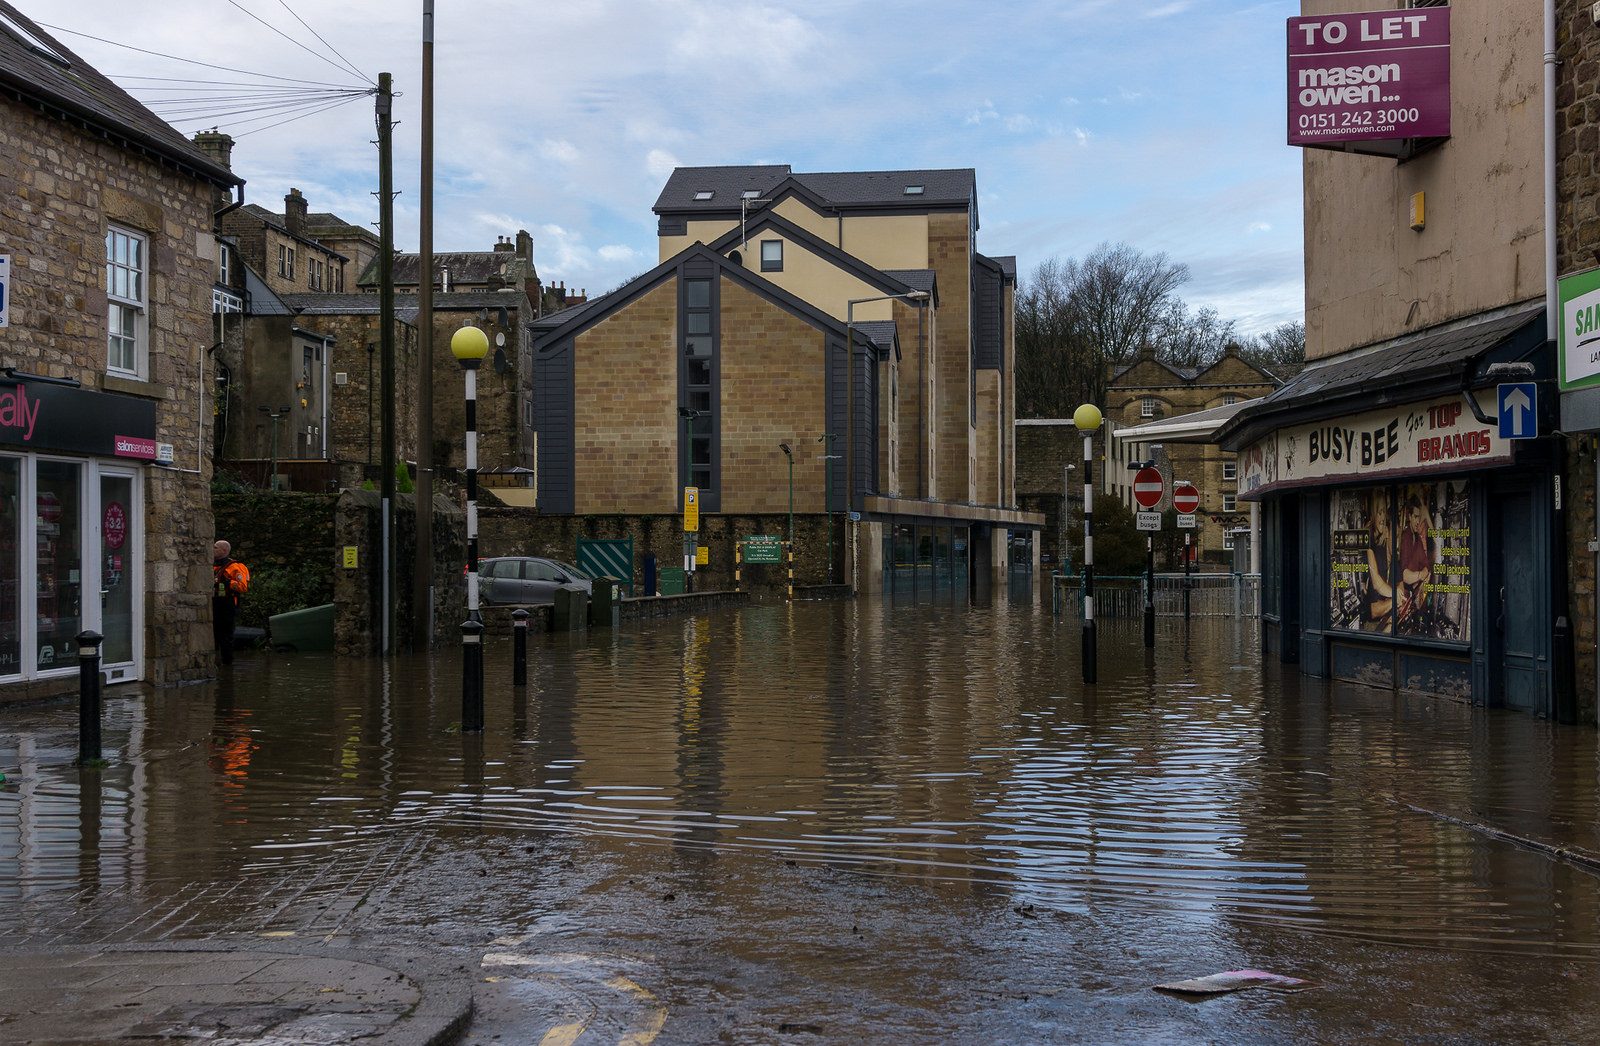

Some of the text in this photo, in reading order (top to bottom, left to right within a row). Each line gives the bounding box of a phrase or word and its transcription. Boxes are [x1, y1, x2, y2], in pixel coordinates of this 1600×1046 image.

[1298, 15, 1427, 46] TO LET
[1298, 63, 1400, 87] mason
[1298, 84, 1400, 107] owen...
[1298, 107, 1419, 128] 0151 242 3000
[1299, 124, 1395, 136] www.masonowen.com
[1405, 401, 1462, 442] For TOP
[1309, 417, 1399, 467] BUSY BEE
[1417, 429, 1491, 463] BRANDS
[1138, 514, 1159, 522] Except
[1211, 515, 1249, 523] YMCA
[1427, 526, 1470, 540] free loyalty card
[1440, 545, 1470, 556] latest slots
[1332, 561, 1369, 575] Gaming centre
[1433, 563, 1470, 577] £500 jackpots
[1423, 581, 1470, 594] free refreshments
